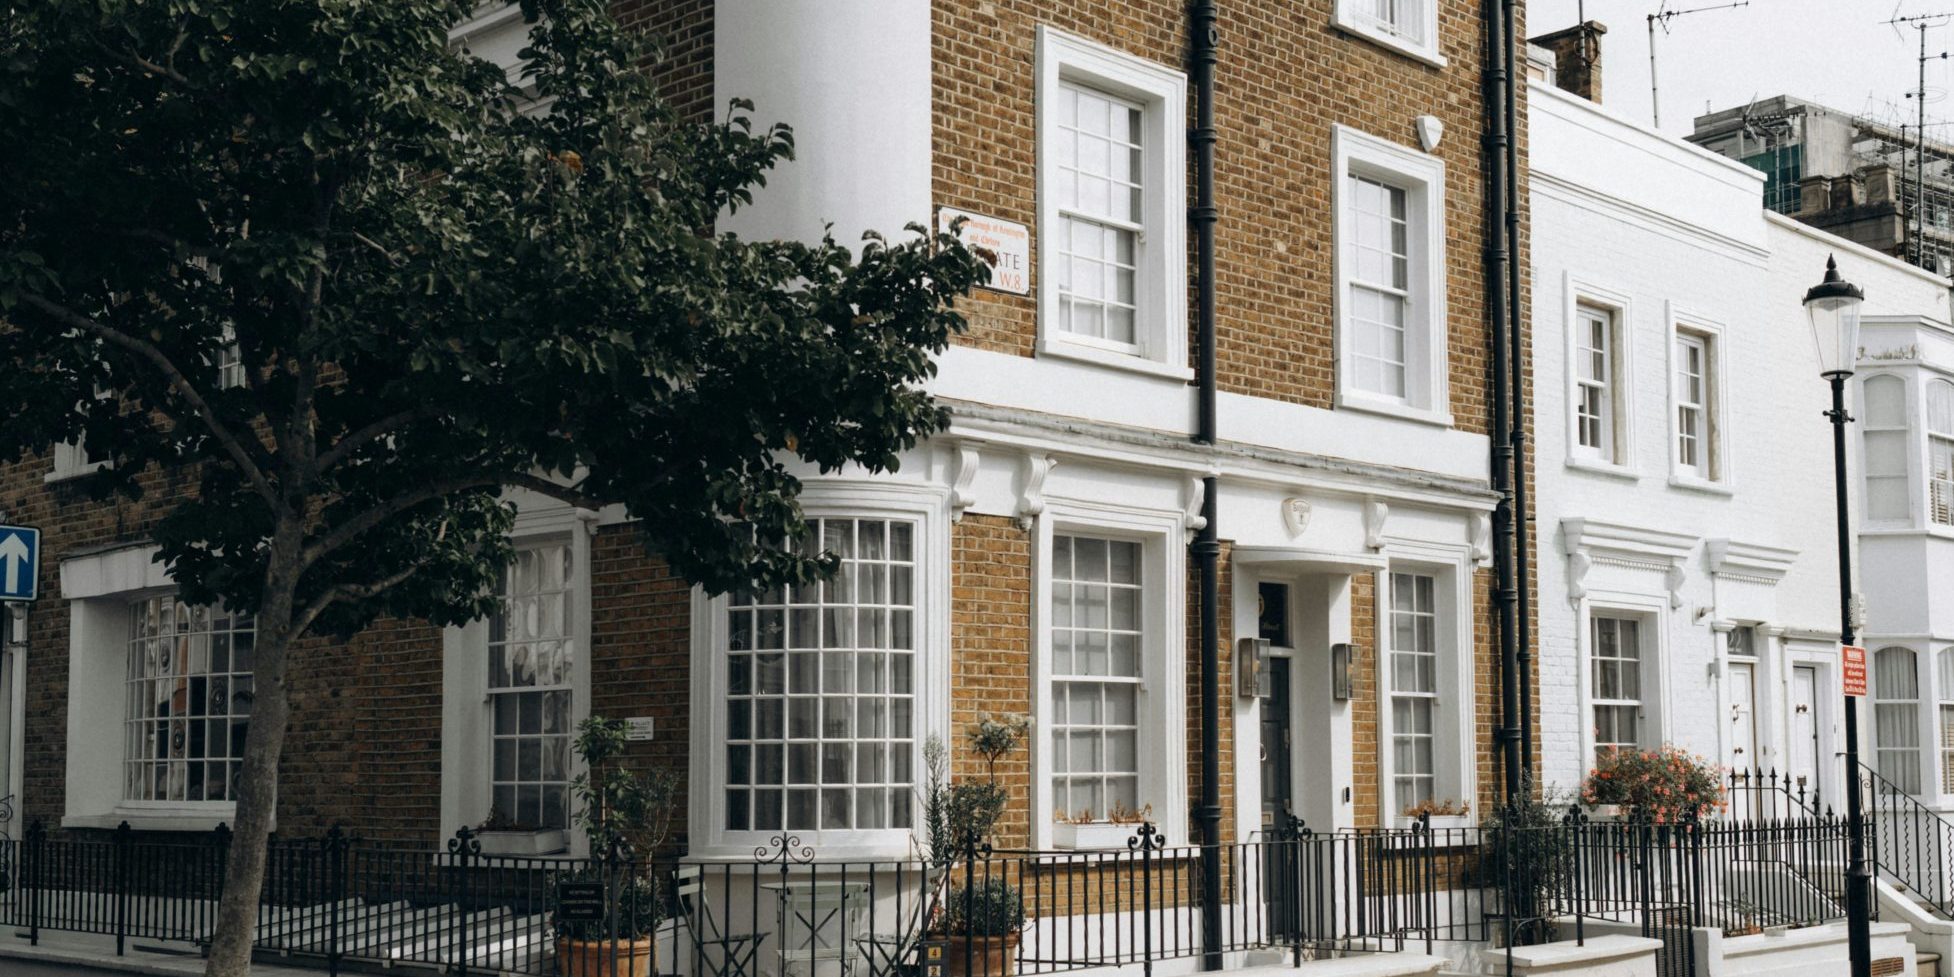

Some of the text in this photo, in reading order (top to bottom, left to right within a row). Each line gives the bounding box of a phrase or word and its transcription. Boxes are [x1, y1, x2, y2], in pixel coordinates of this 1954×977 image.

[995, 251, 1020, 270] ATE
[932, 949, 937, 957] 4
[931, 967, 937, 976] 2
